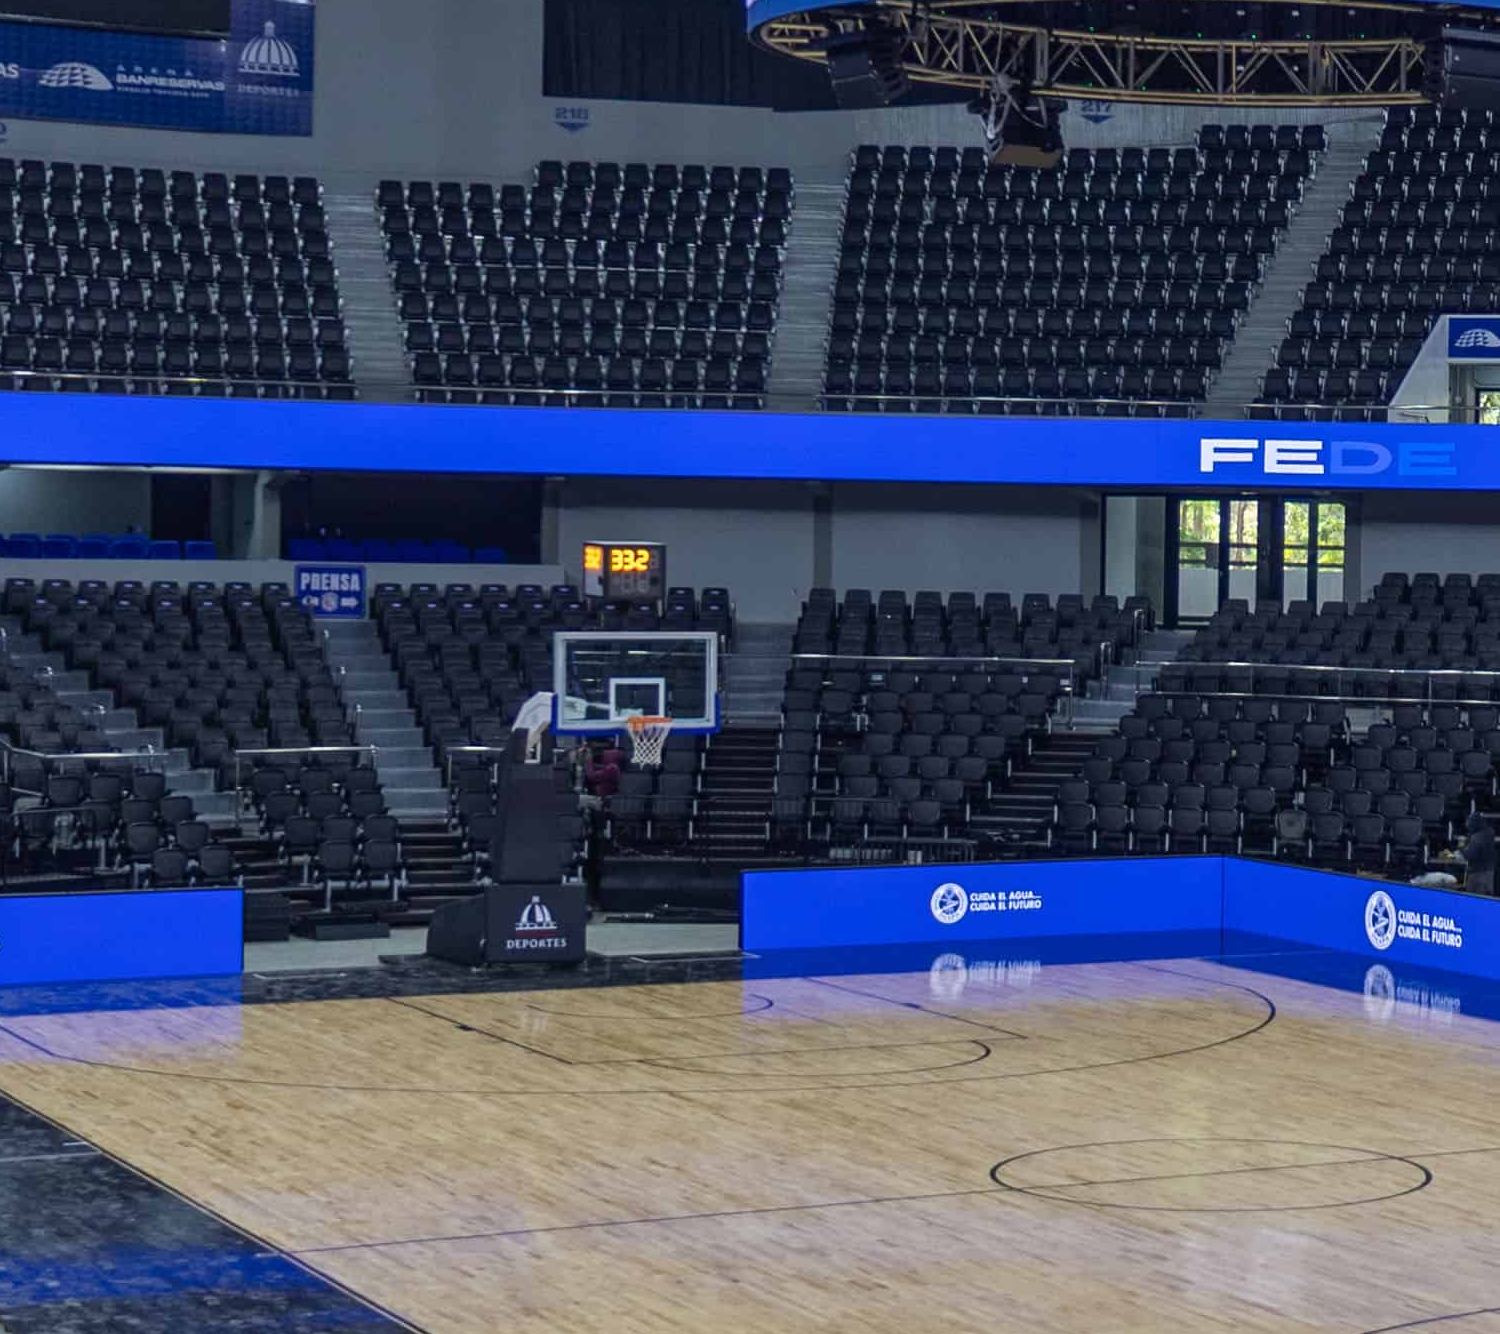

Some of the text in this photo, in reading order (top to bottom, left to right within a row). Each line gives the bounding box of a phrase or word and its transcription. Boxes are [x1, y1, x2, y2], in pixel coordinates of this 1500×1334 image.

[116, 73, 226, 92] BANRESERVAS
[300, 571, 361, 592] PRENSA
[969, 892, 997, 902] CUIDA
[998, 891, 1008, 902] EL
[969, 899, 1041, 912] CUIDA EL FUTURO
[1397, 910, 1421, 926] CUIDA
[1422, 913, 1431, 927] EL
[506, 937, 567, 950] DEPORTES
[1397, 924, 1462, 948] CUIDA EL FUTURO
